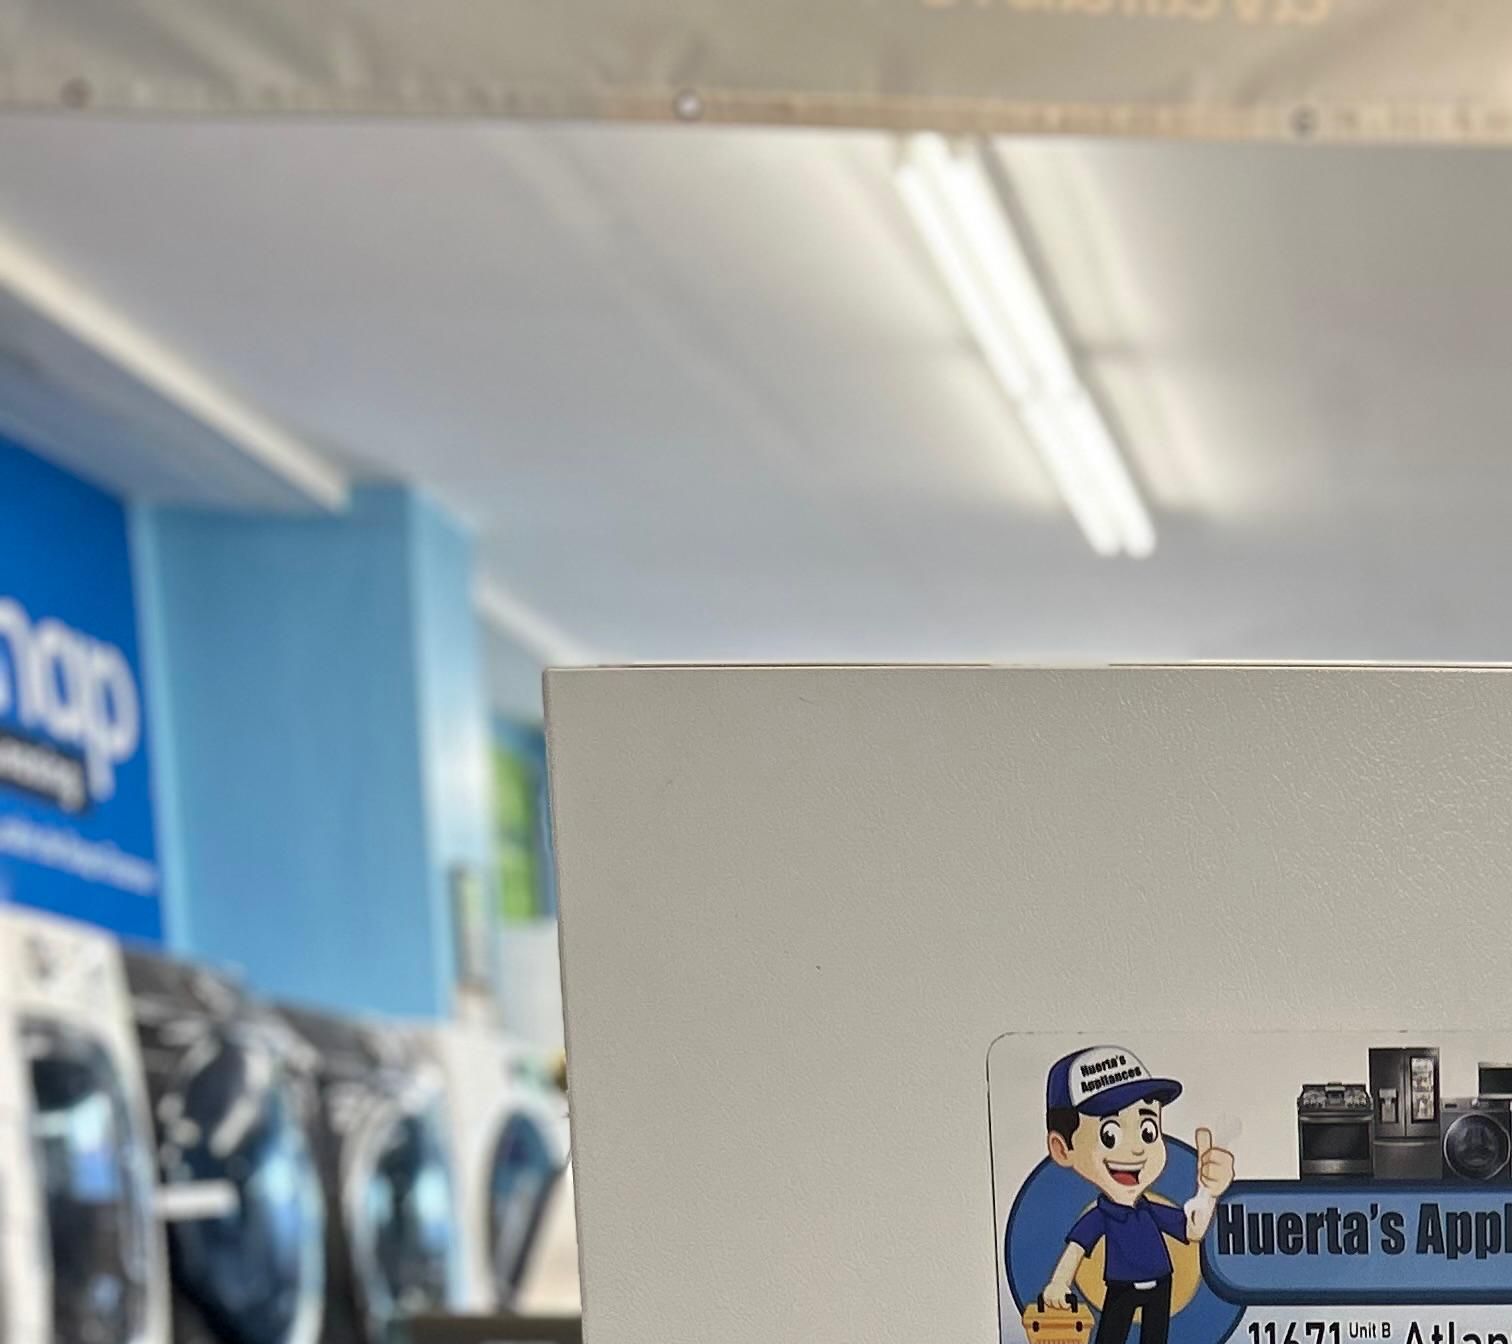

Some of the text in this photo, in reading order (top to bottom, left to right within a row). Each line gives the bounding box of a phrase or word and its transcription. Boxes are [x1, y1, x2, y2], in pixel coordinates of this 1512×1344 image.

[1080, 1055, 1126, 1077] Huerta's
[1081, 1066, 1142, 1093] Appliances
[1217, 1203, 1405, 1255] Huerta's
[1349, 1321, 1376, 1338] Unit
[1382, 1321, 1391, 1338] B
